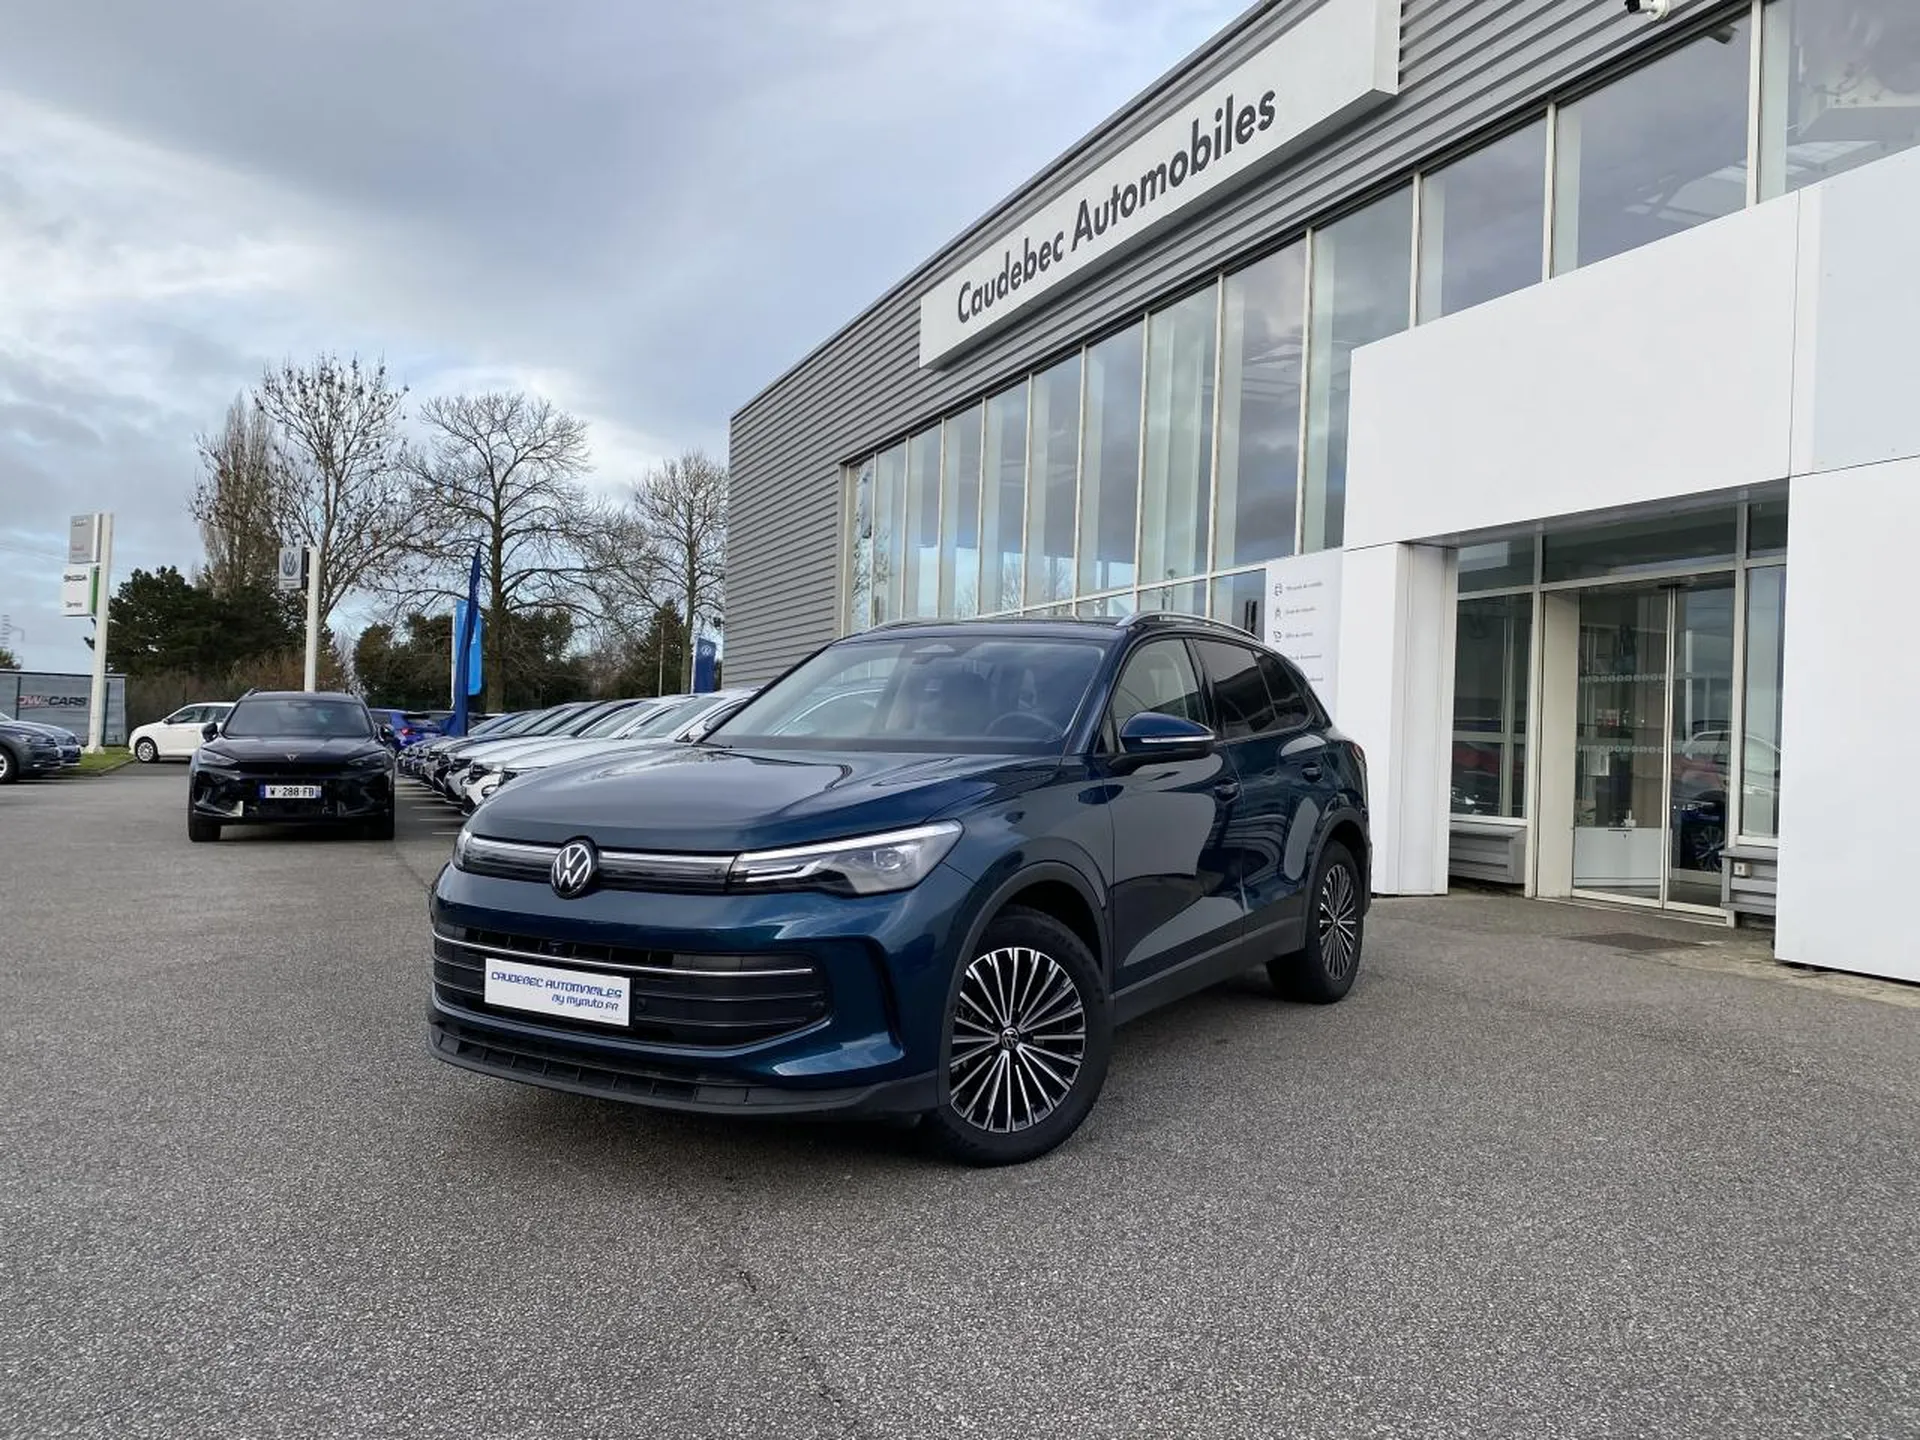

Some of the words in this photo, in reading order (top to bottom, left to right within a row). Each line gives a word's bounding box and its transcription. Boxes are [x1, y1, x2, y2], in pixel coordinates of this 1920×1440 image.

[957, 229, 1065, 324] Caudebec
[1071, 89, 1276, 252] Automobiles
[48, 695, 87, 706] CARS
[491, 971, 544, 989] CAUDEBEC
[545, 979, 622, 999] AUTOMOBILES
